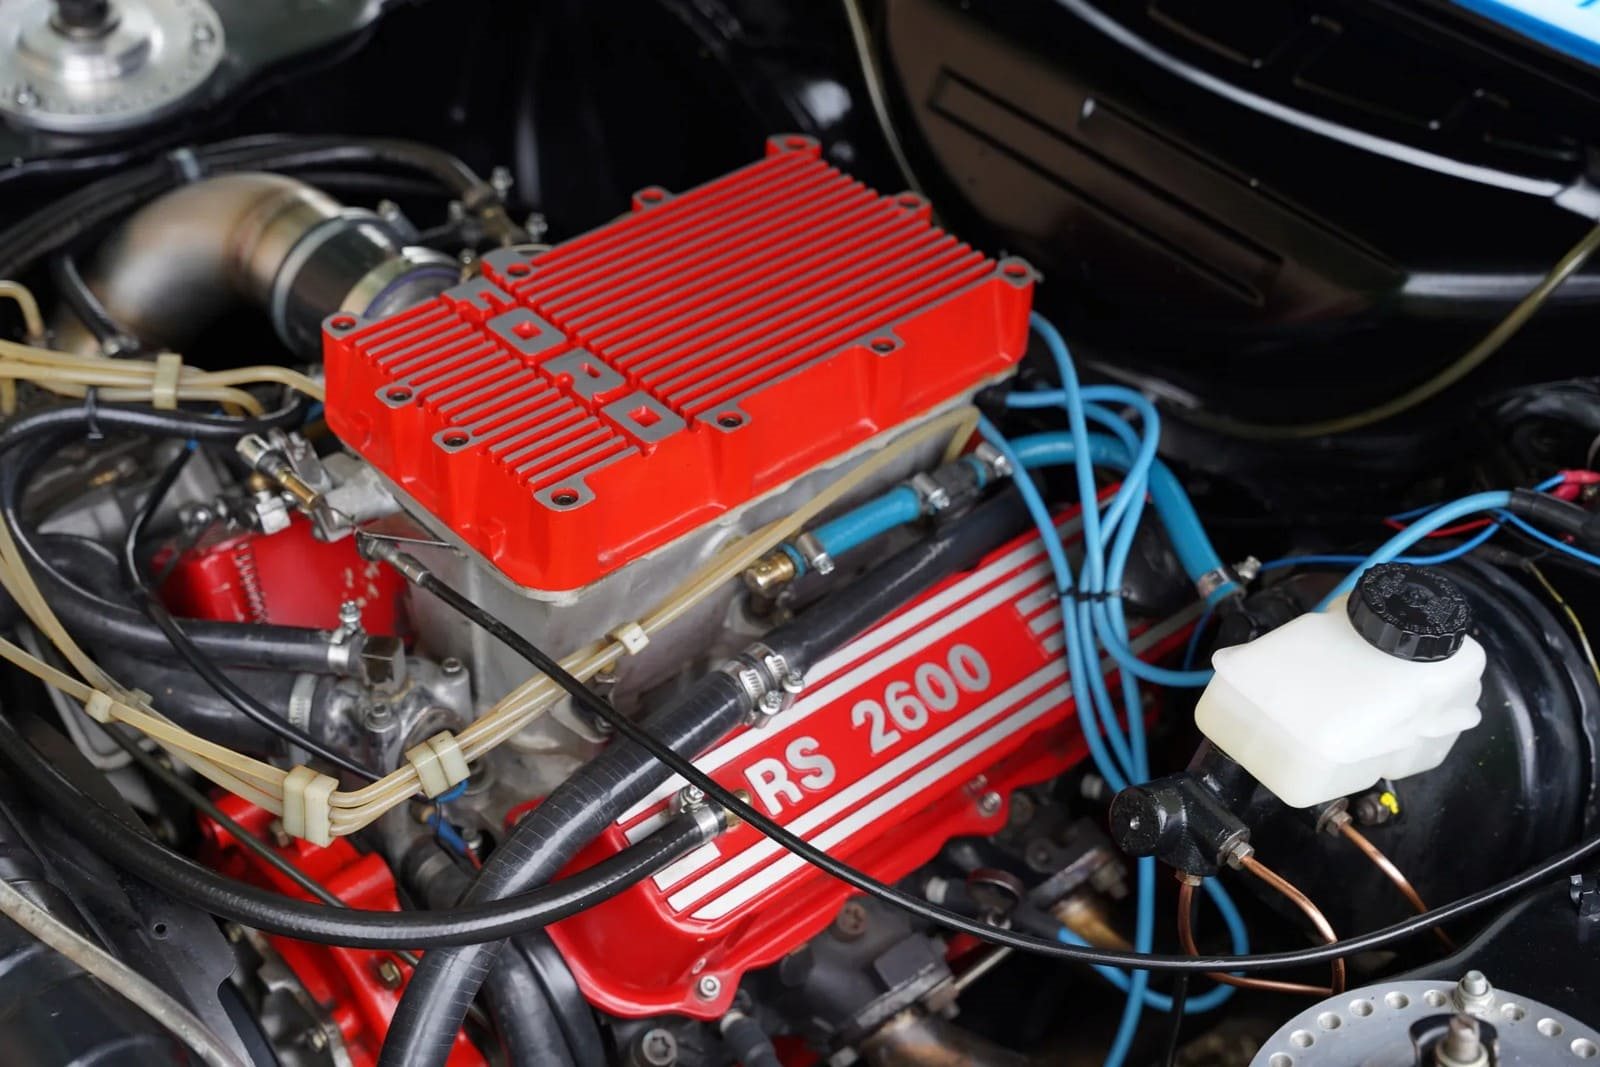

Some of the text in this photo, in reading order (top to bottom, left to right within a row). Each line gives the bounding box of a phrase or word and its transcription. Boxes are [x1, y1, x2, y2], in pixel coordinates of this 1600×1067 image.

[442, 277, 686, 443] FORD
[744, 643, 991, 816] RS 2600
